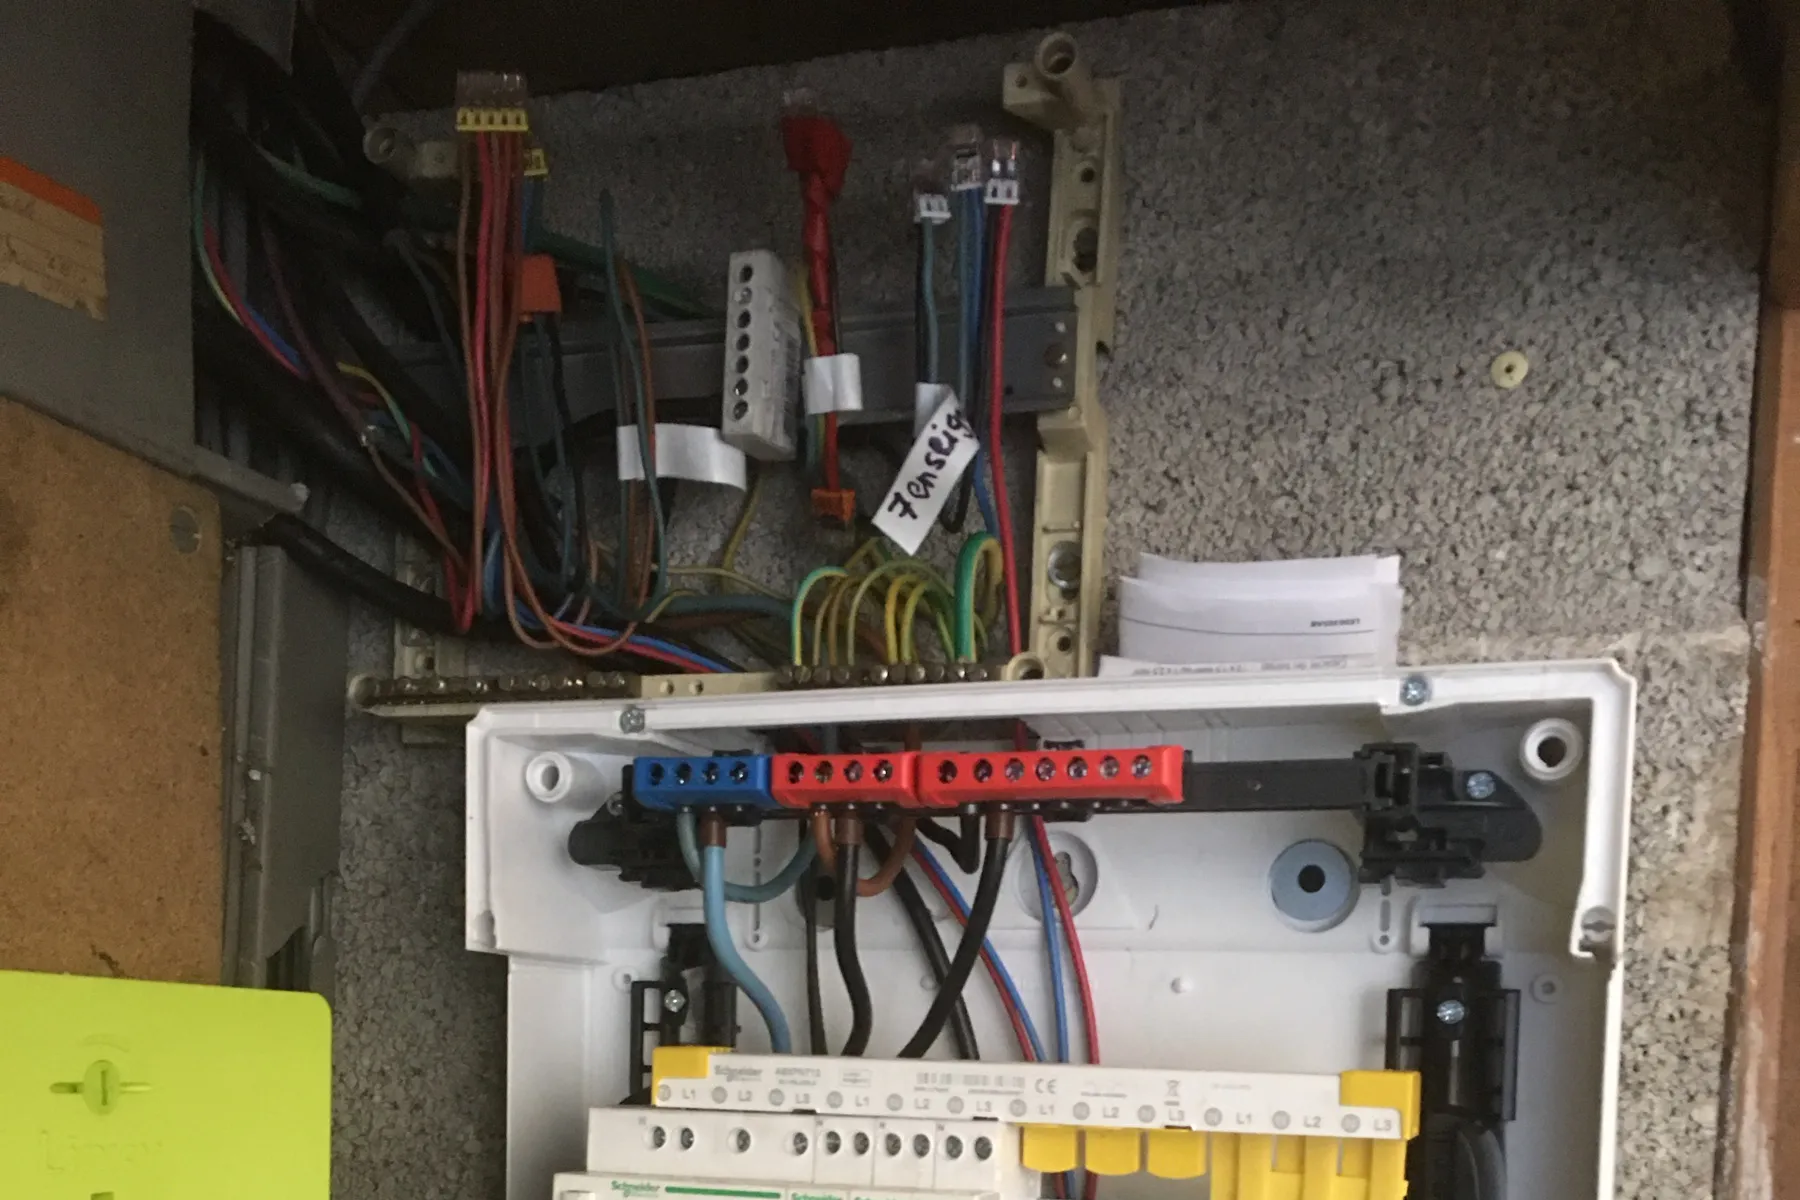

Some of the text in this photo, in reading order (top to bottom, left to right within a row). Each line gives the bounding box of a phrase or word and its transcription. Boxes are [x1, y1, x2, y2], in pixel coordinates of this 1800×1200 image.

[682, 1089, 1392, 1131] L1 L2 L3 L1 L2 L3 L1 L2 L3 L1 L2 L3
[611, 1180, 661, 1197] Schneider
